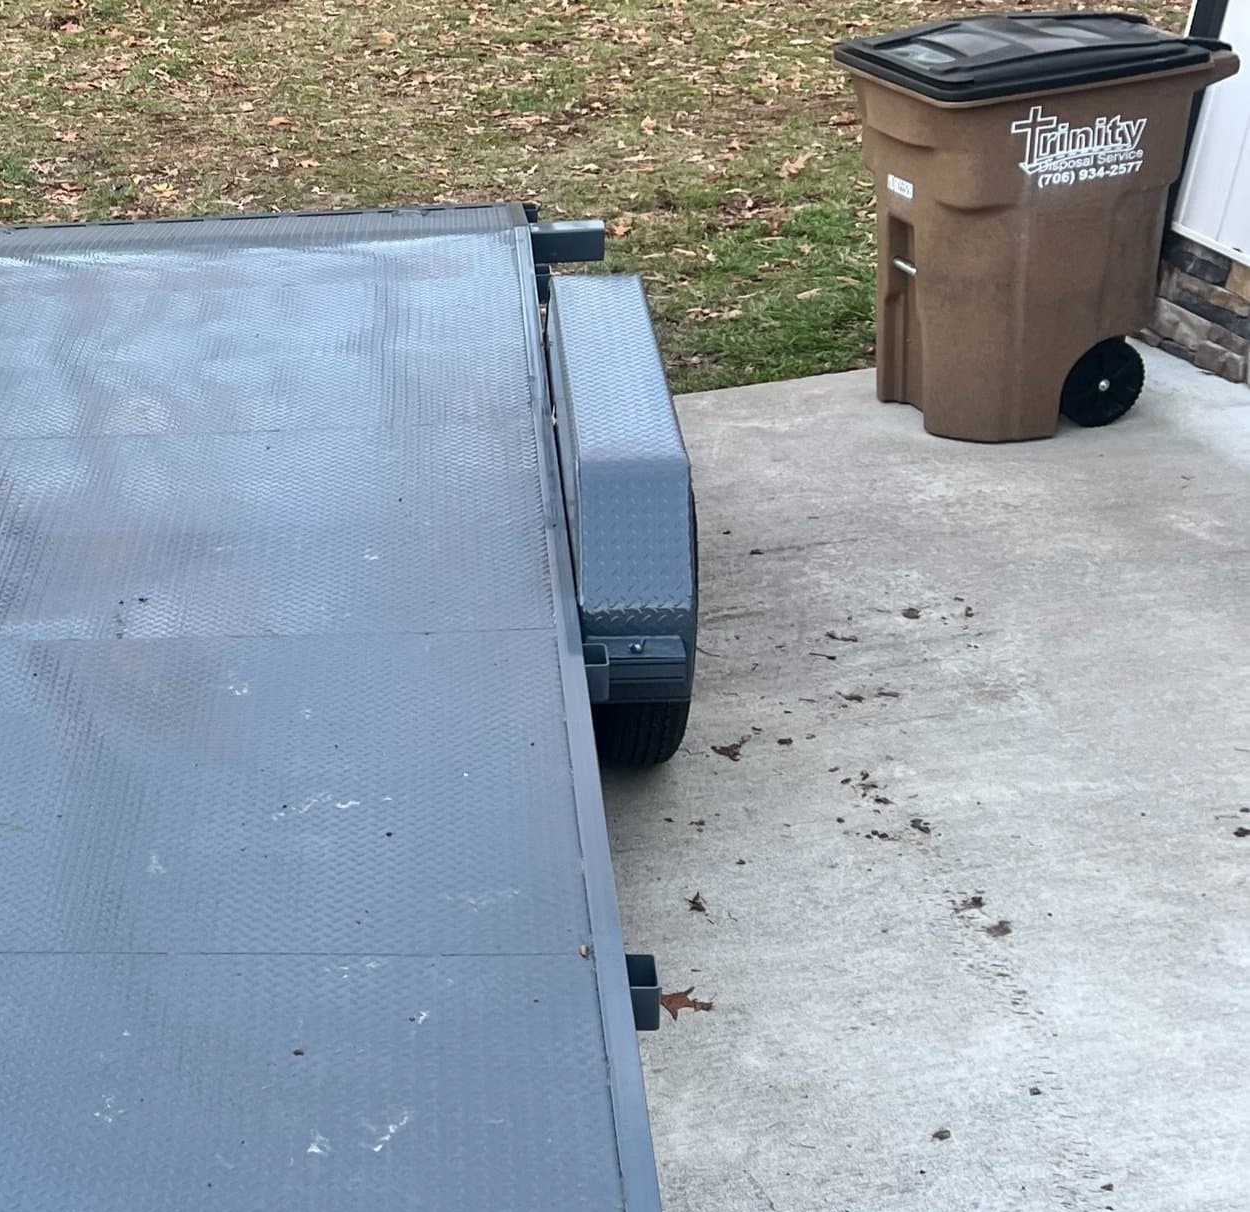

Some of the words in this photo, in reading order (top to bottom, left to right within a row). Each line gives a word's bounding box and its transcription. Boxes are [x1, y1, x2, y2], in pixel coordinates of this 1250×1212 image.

[1011, 105, 1147, 168] Trinity
[1036, 155, 1095, 173] Disposal
[1096, 149, 1144, 167] Service
[1037, 170, 1076, 188] (706)
[1078, 160, 1143, 181] 934-2577
